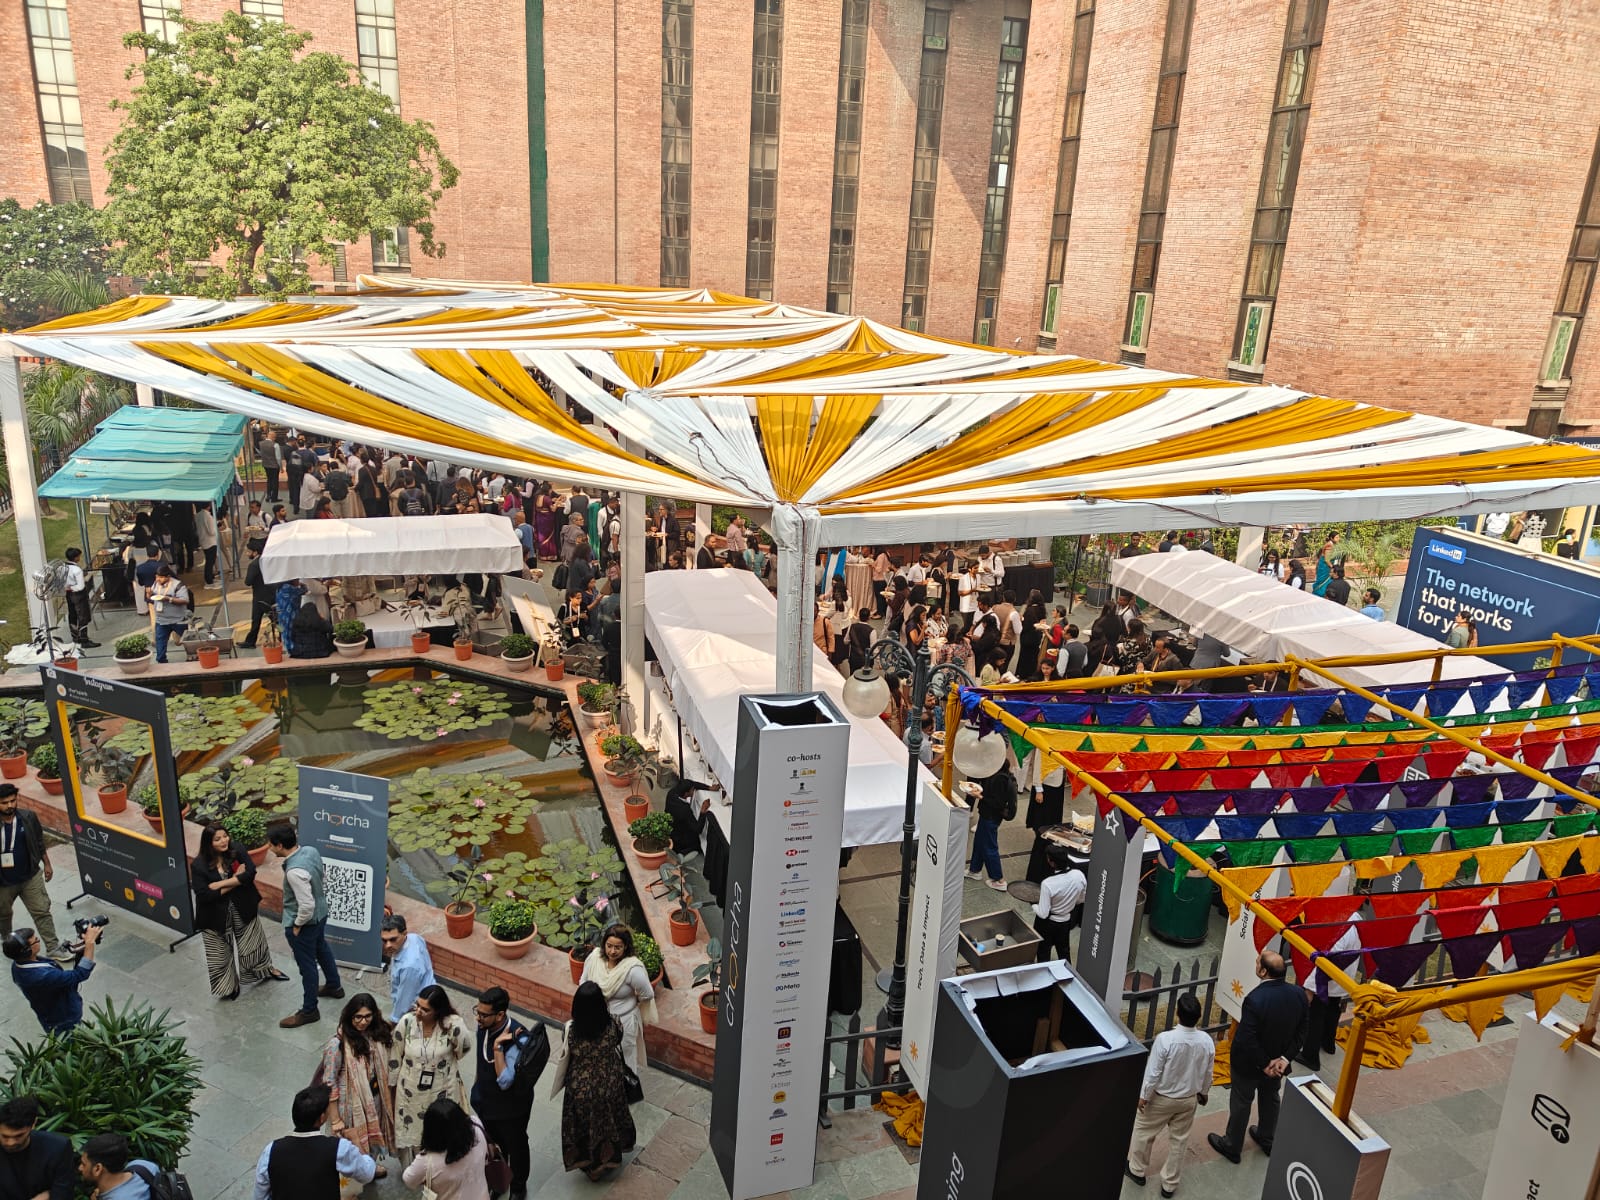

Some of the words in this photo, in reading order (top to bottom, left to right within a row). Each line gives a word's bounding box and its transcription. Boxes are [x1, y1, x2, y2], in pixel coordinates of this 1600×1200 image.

[1426, 567, 1457, 591] The
[1459, 582, 1536, 618] network
[1417, 605, 1442, 627] for
[1421, 587, 1457, 613] that
[1460, 602, 1513, 632] works
[786, 753, 822, 763] co-hosts
[1391, 871, 1403, 893] olicy
[923, 894, 931, 930] Impact
[1091, 933, 1100, 959] Skills
[1096, 868, 1108, 924] Livelihoods
[1240, 911, 1249, 940] Social
